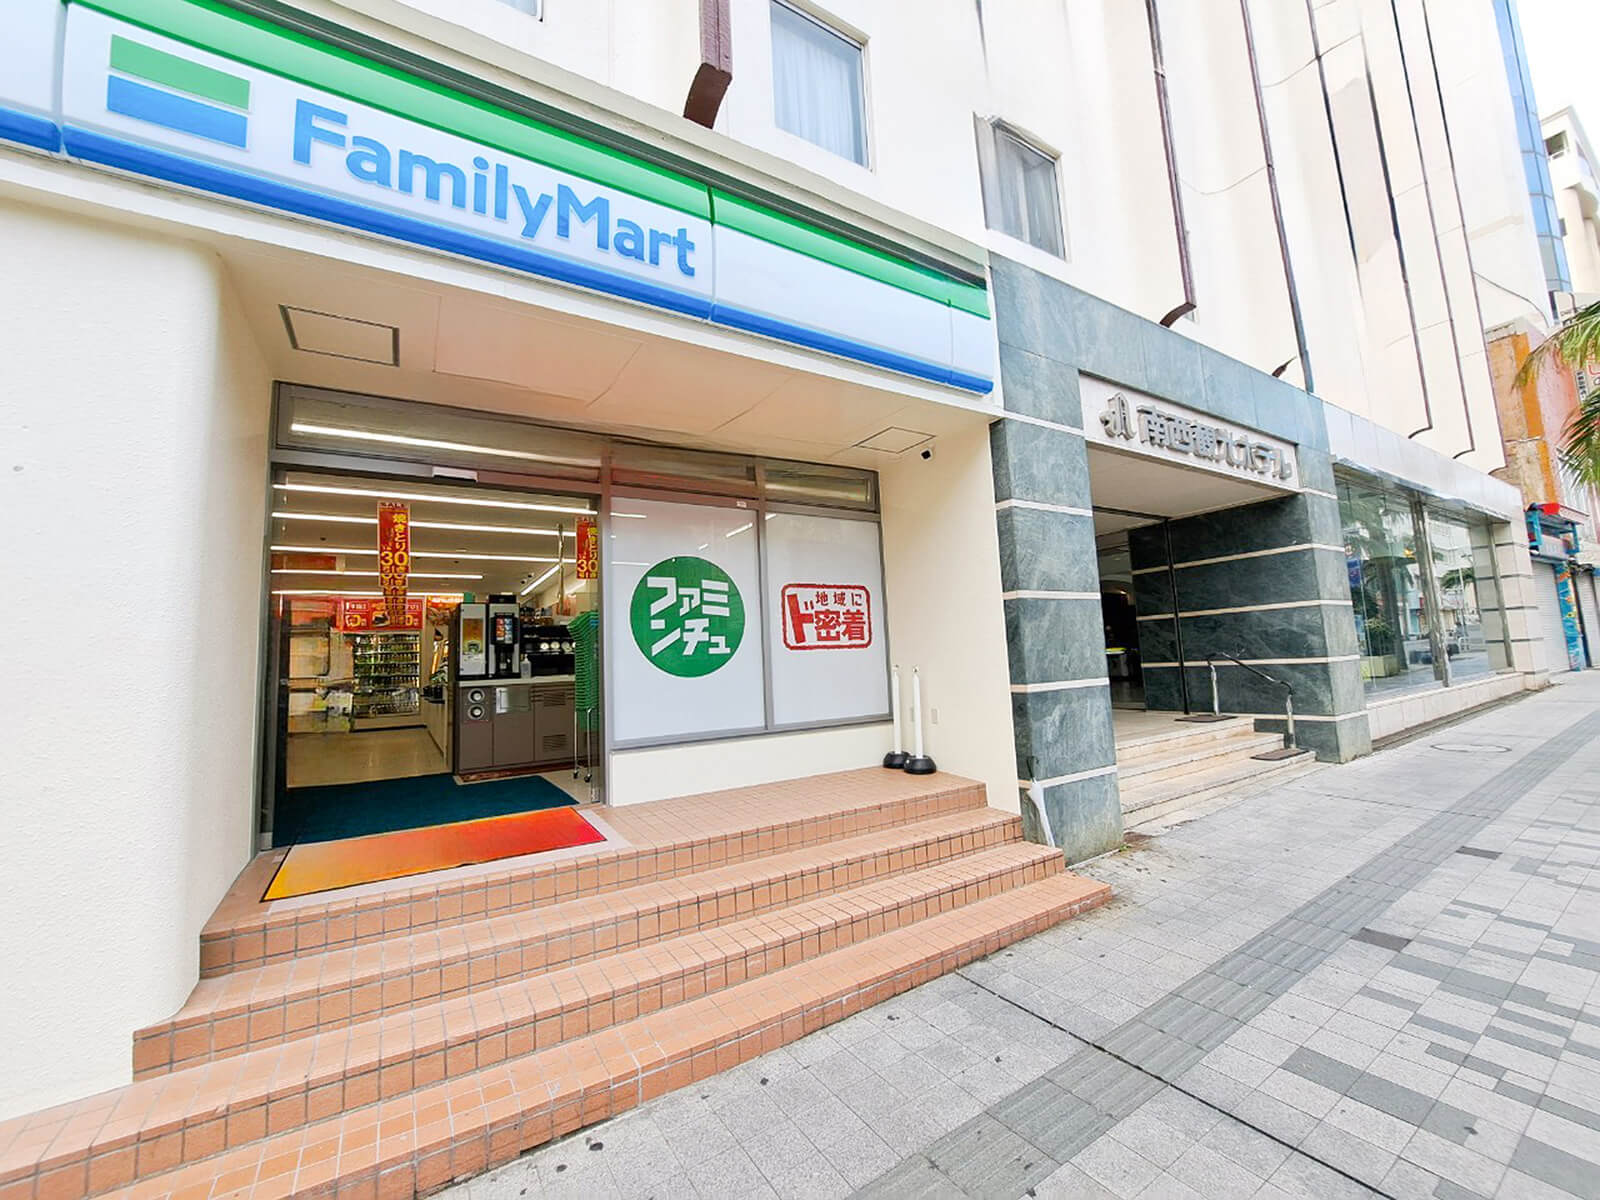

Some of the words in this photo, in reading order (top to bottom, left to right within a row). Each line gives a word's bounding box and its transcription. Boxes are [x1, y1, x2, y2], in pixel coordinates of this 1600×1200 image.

[293, 98, 695, 277] FamilyMart
[381, 551, 408, 566] 30
[577, 559, 598, 572] 30
[647, 576, 730, 616] ファミ
[815, 591, 863, 606] 地域に
[651, 618, 731, 657] ンチュ
[787, 593, 866, 644] ド密着
